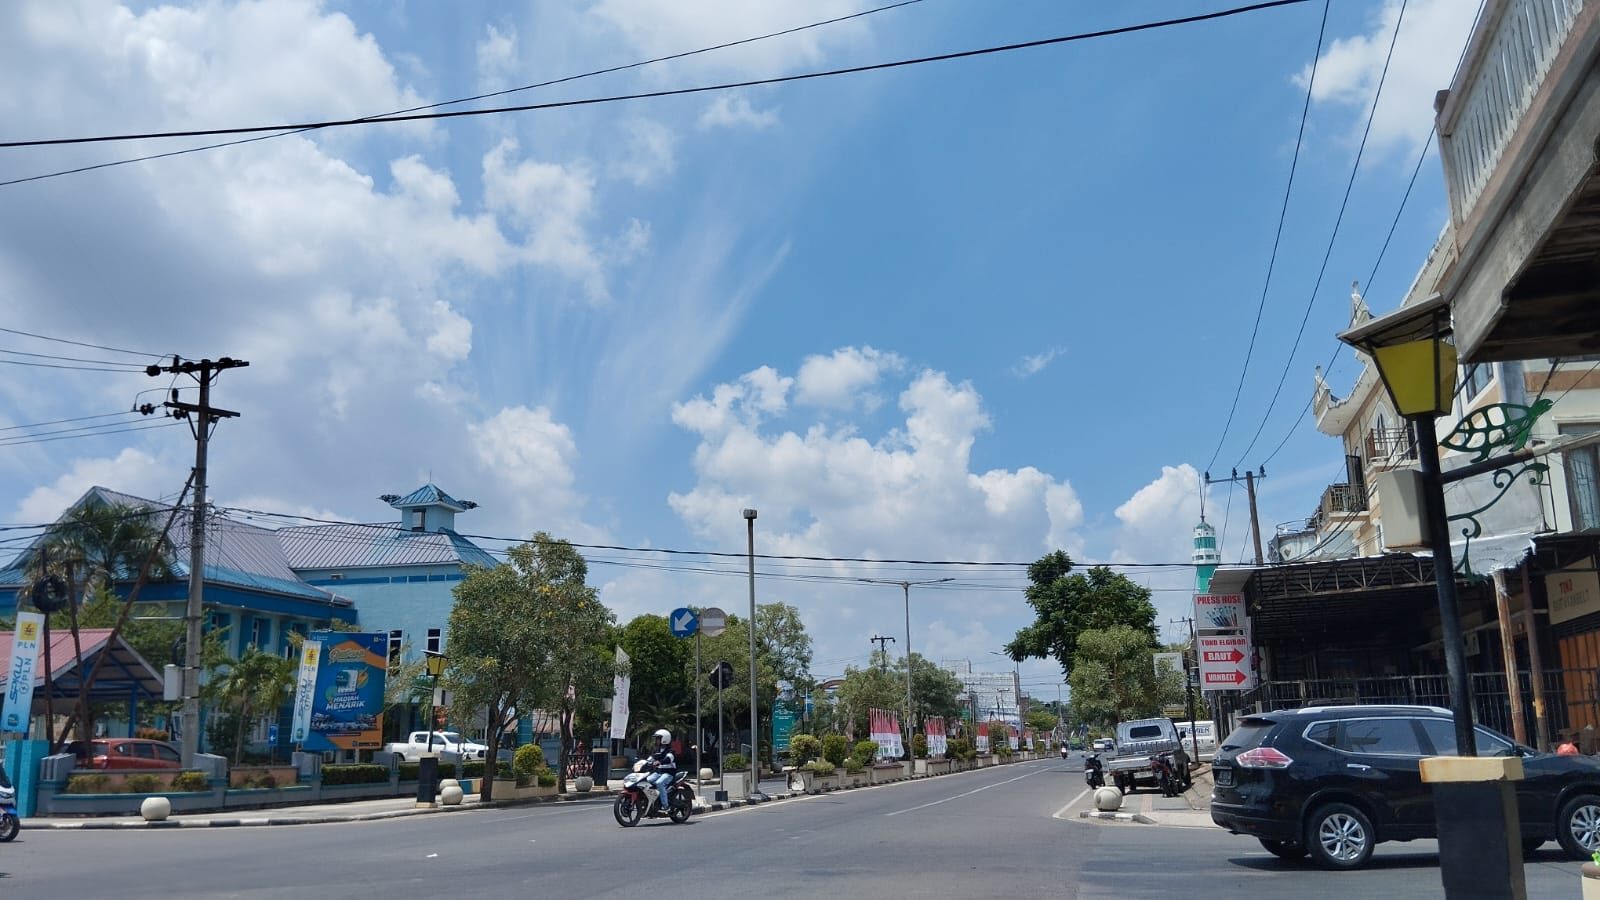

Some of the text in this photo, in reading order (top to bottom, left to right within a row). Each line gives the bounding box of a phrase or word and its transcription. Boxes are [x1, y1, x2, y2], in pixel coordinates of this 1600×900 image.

[1196, 595, 1242, 605] PRESS HOSE
[17, 641, 36, 649] PLN
[1207, 652, 1232, 661] BAUT
[22, 658, 32, 682] PLN
[1207, 673, 1236, 682] VANBELT
[326, 701, 365, 710] MENARIK
